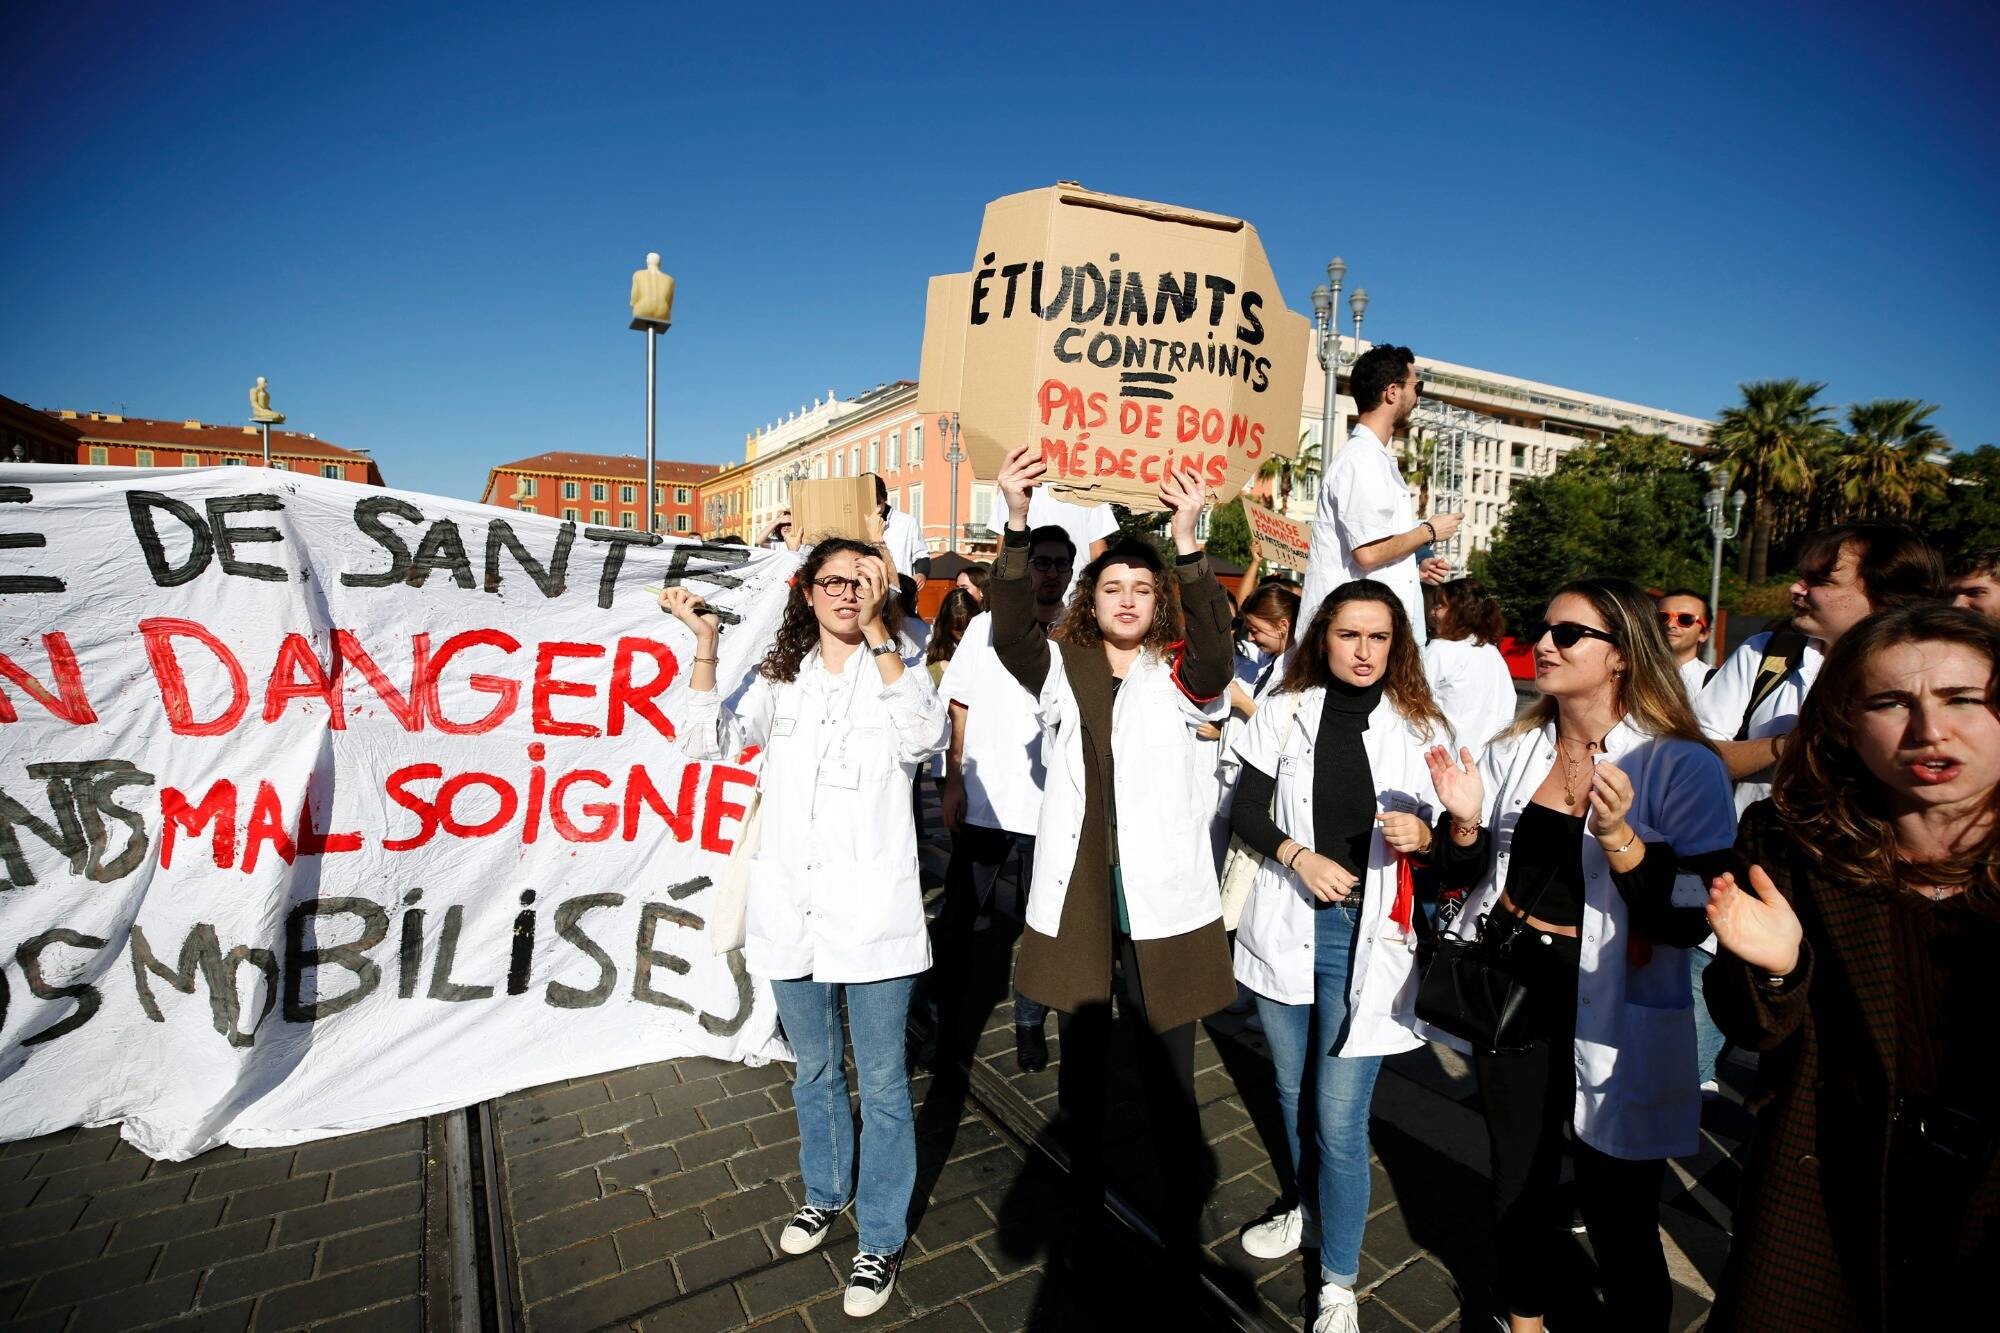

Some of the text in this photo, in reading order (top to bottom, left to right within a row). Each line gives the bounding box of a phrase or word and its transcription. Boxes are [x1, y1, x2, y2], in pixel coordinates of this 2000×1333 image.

[1037, 378, 1265, 460] PAS DE BONS
[126, 490, 289, 587] DE
[139, 617, 679, 742] DANGER
[160, 778, 364, 875] MAL
